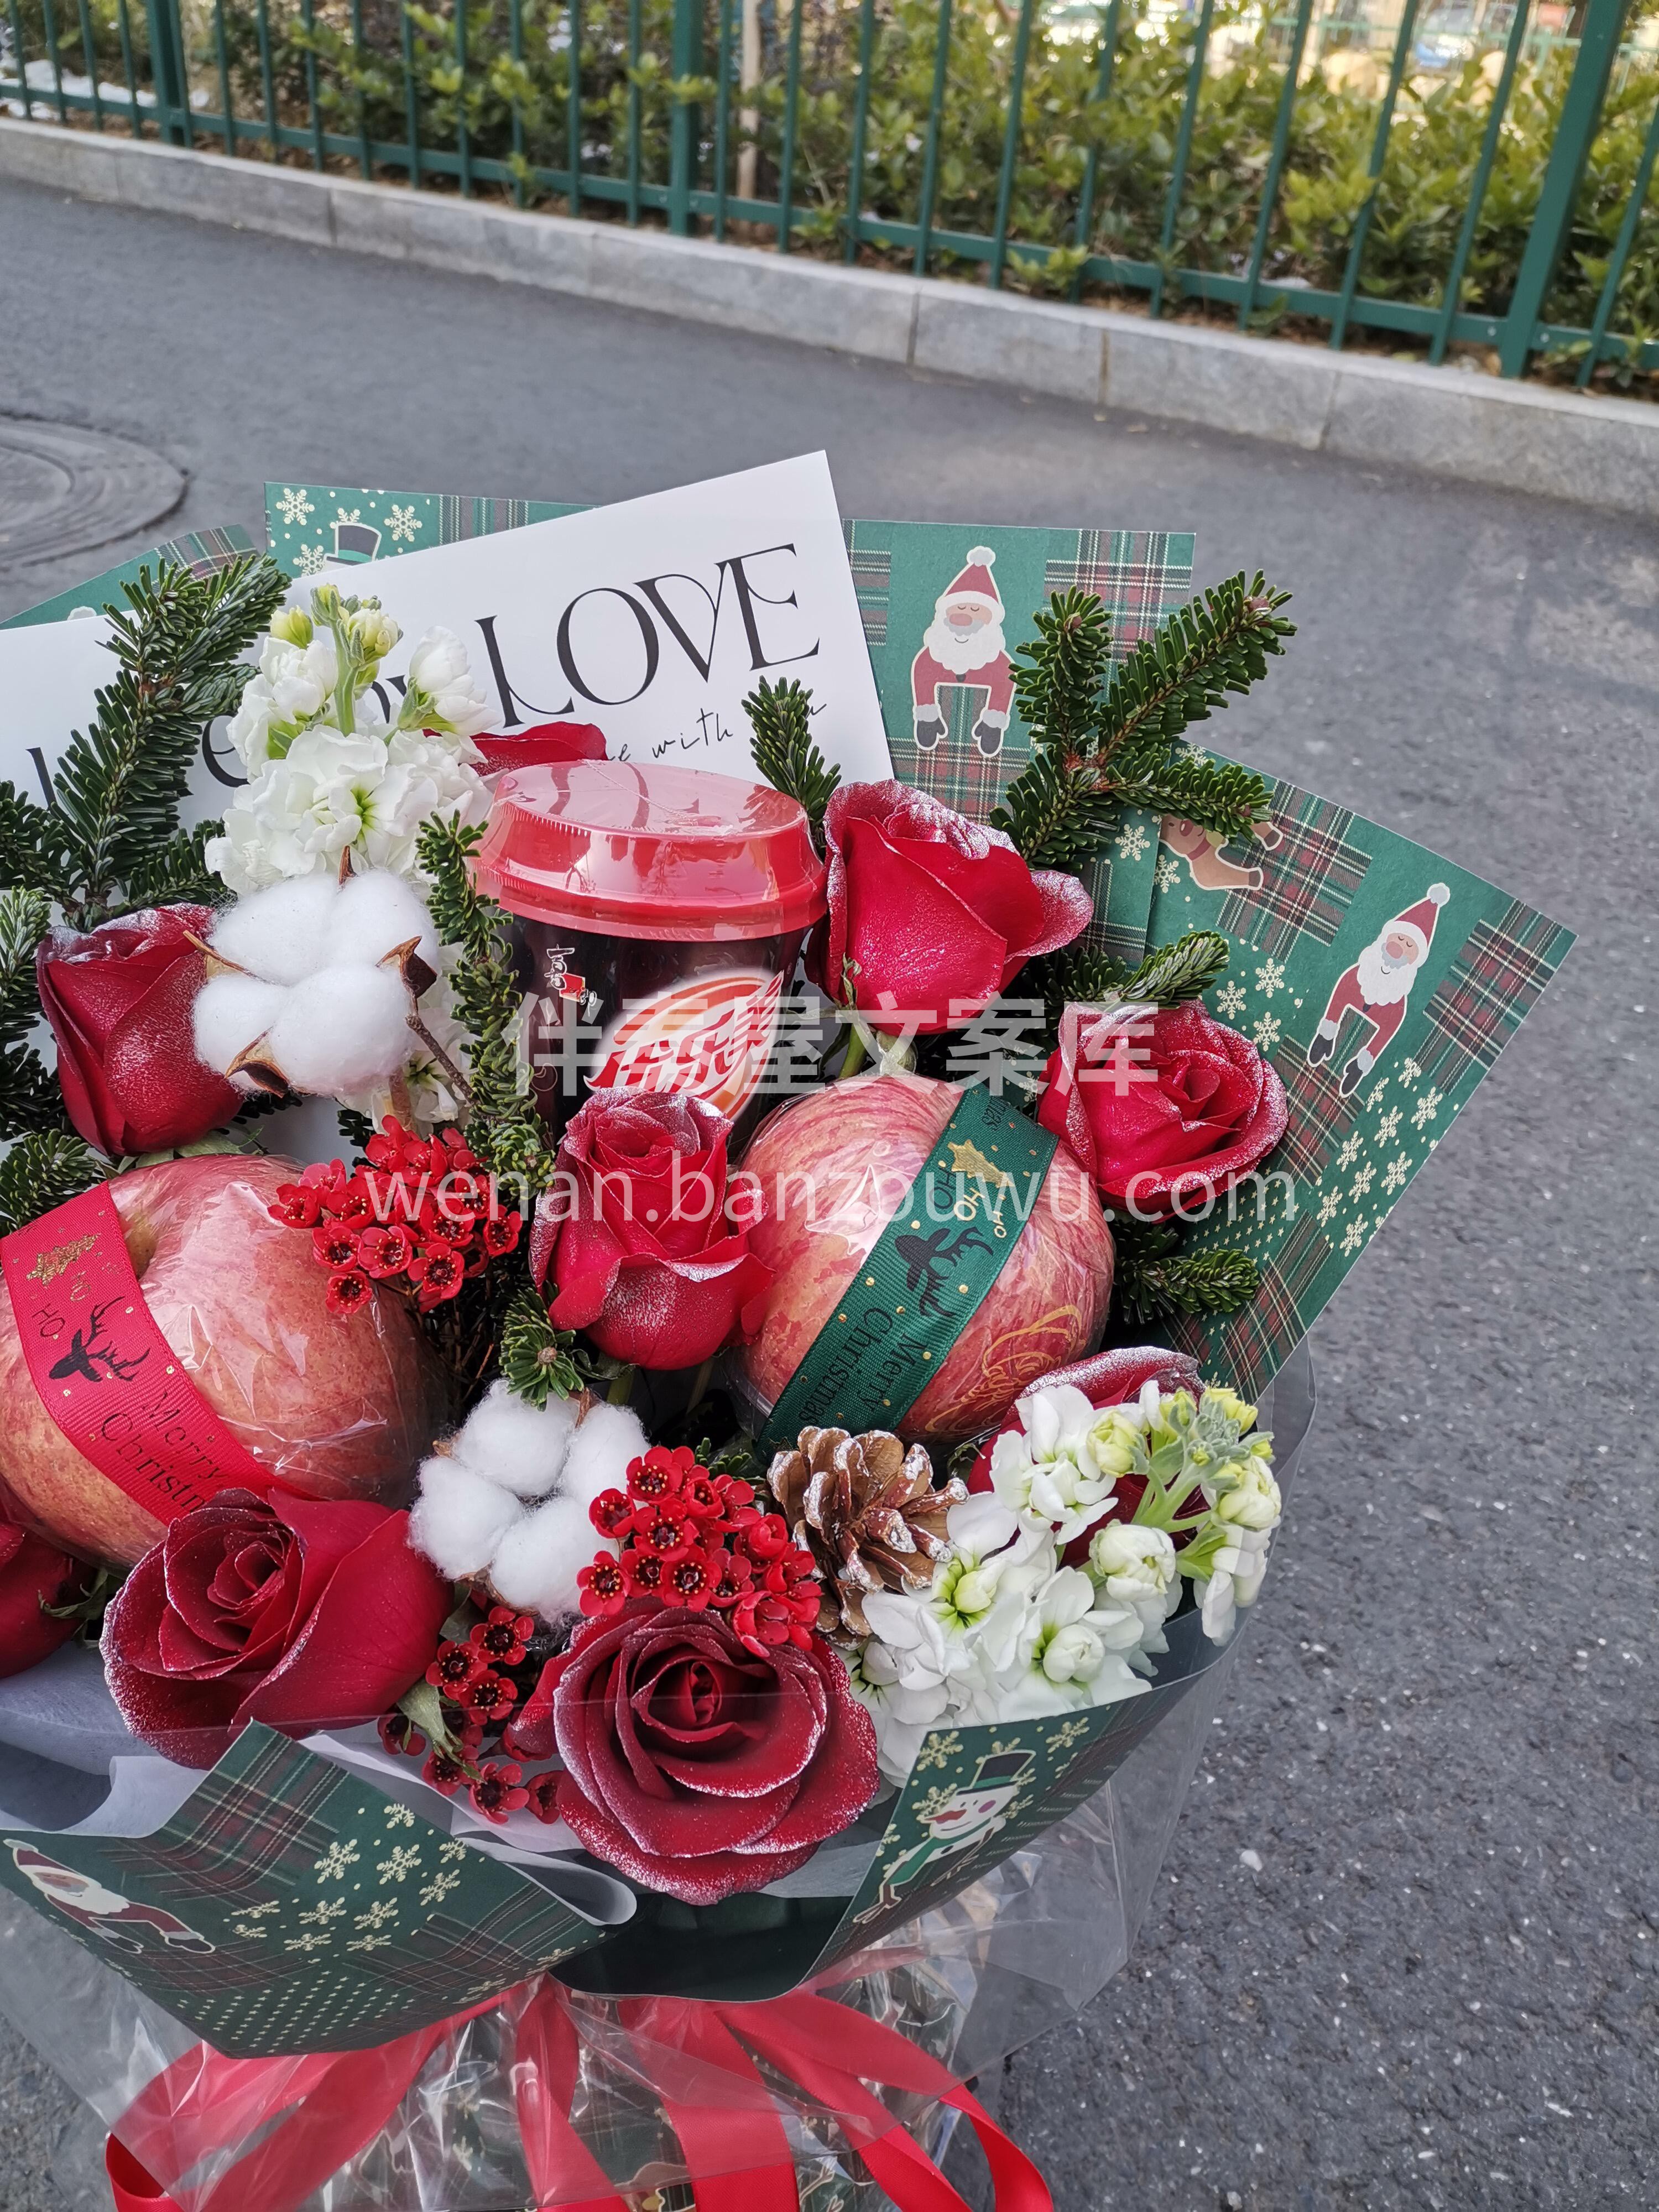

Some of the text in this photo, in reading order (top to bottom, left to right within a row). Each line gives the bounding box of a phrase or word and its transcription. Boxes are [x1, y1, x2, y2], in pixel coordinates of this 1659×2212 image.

[474, 543, 820, 728] LOVE
[651, 708, 733, 758] with
[953, 1188, 985, 1221] HO
[799, 1307, 893, 1425] Christmas
[858, 1333, 928, 1411] Merry
[102, 1412, 206, 1514] Christm
[143, 1391, 227, 1480] Merry
